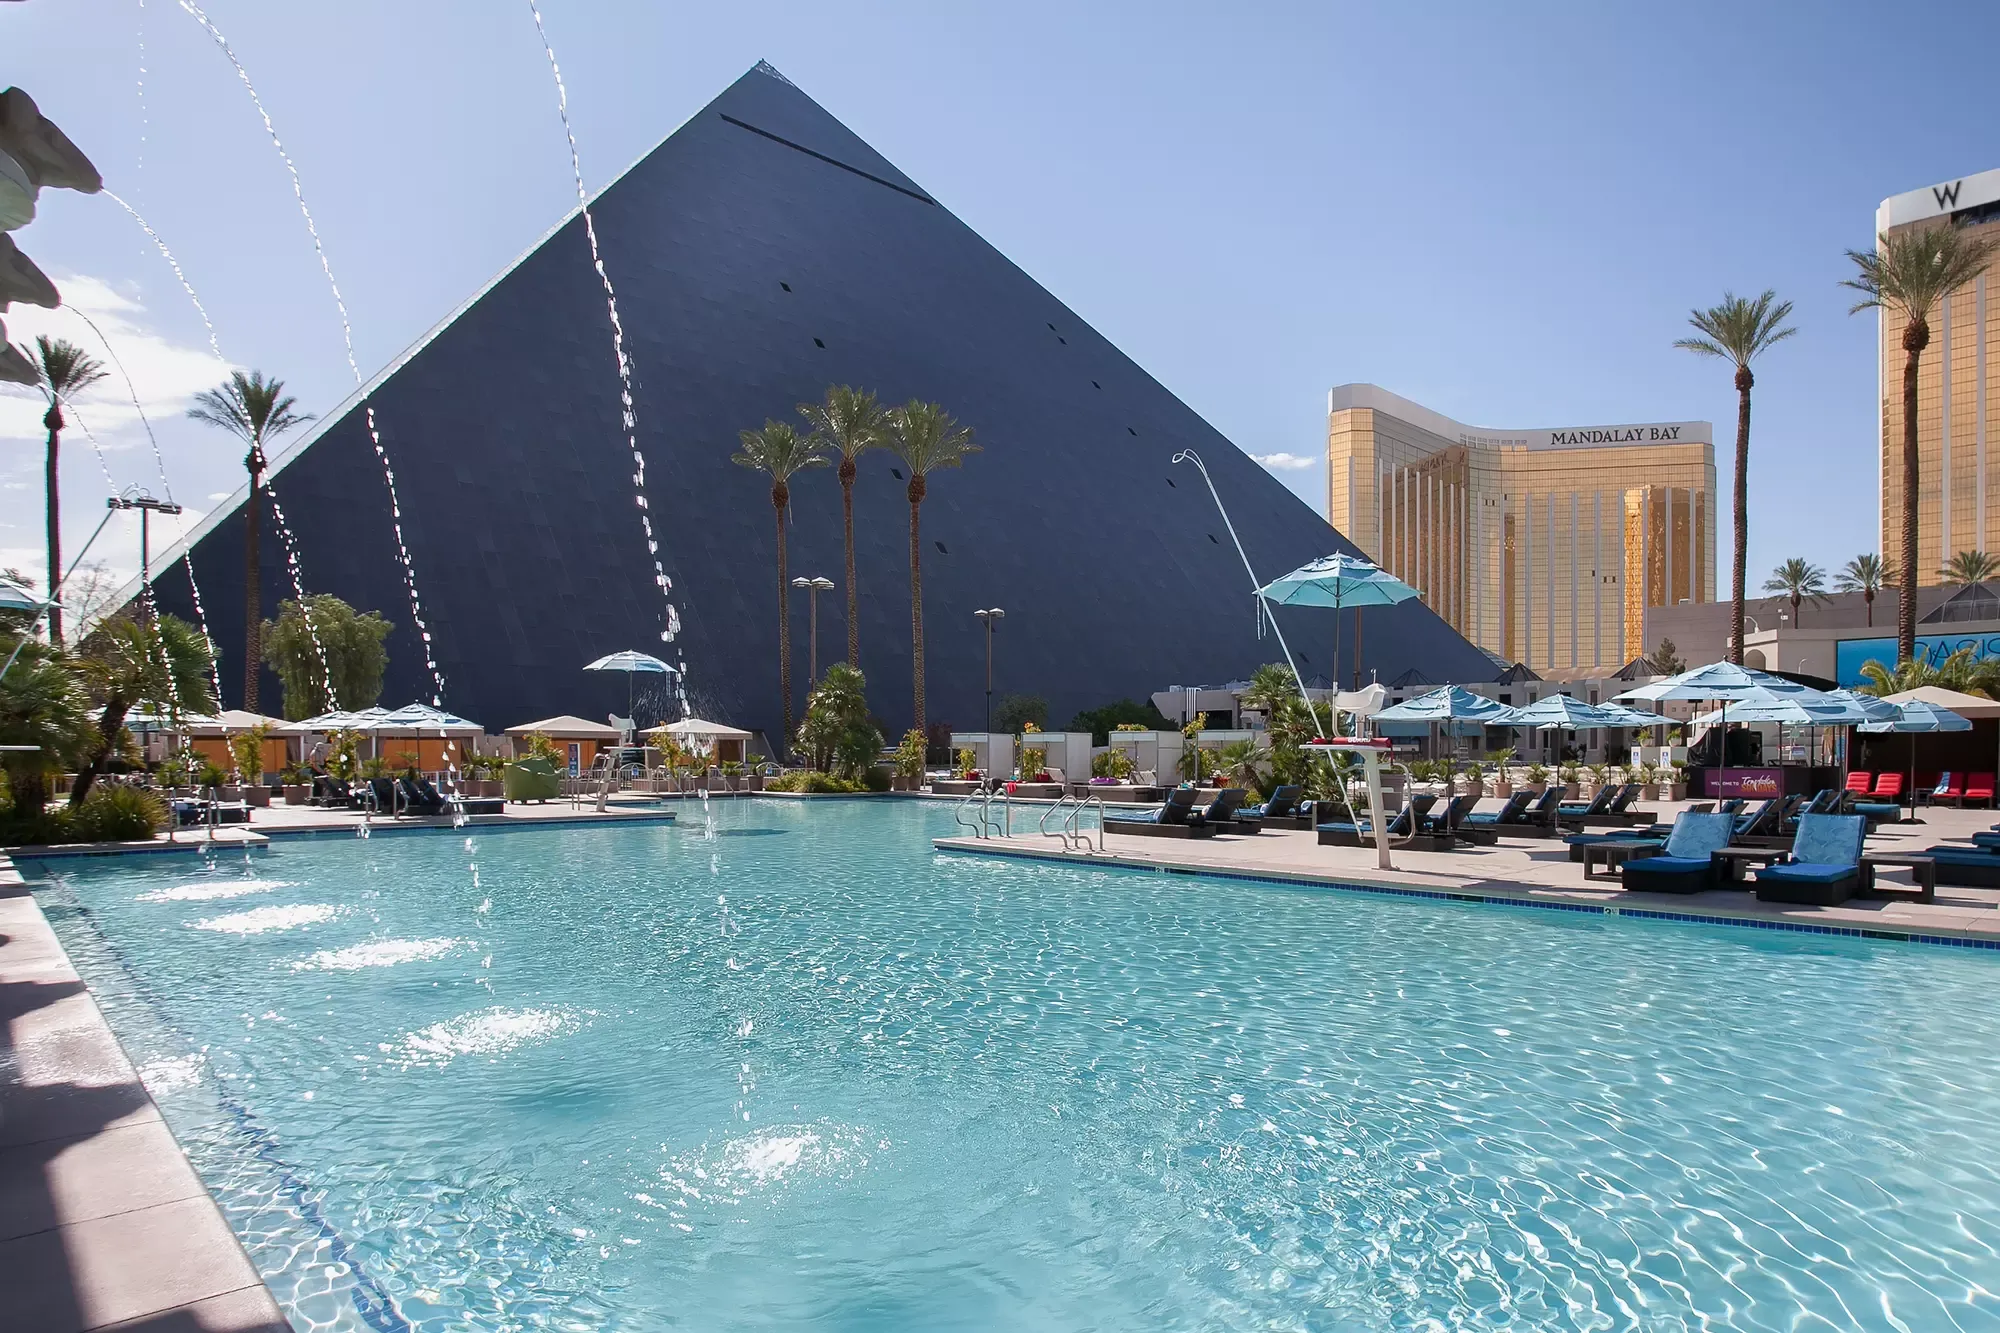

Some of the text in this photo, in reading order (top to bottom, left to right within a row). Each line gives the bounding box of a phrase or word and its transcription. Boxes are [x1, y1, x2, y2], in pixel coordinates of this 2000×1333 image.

[1932, 180, 1962, 210] W
[1551, 426, 1681, 445] MANDALAY BAY
